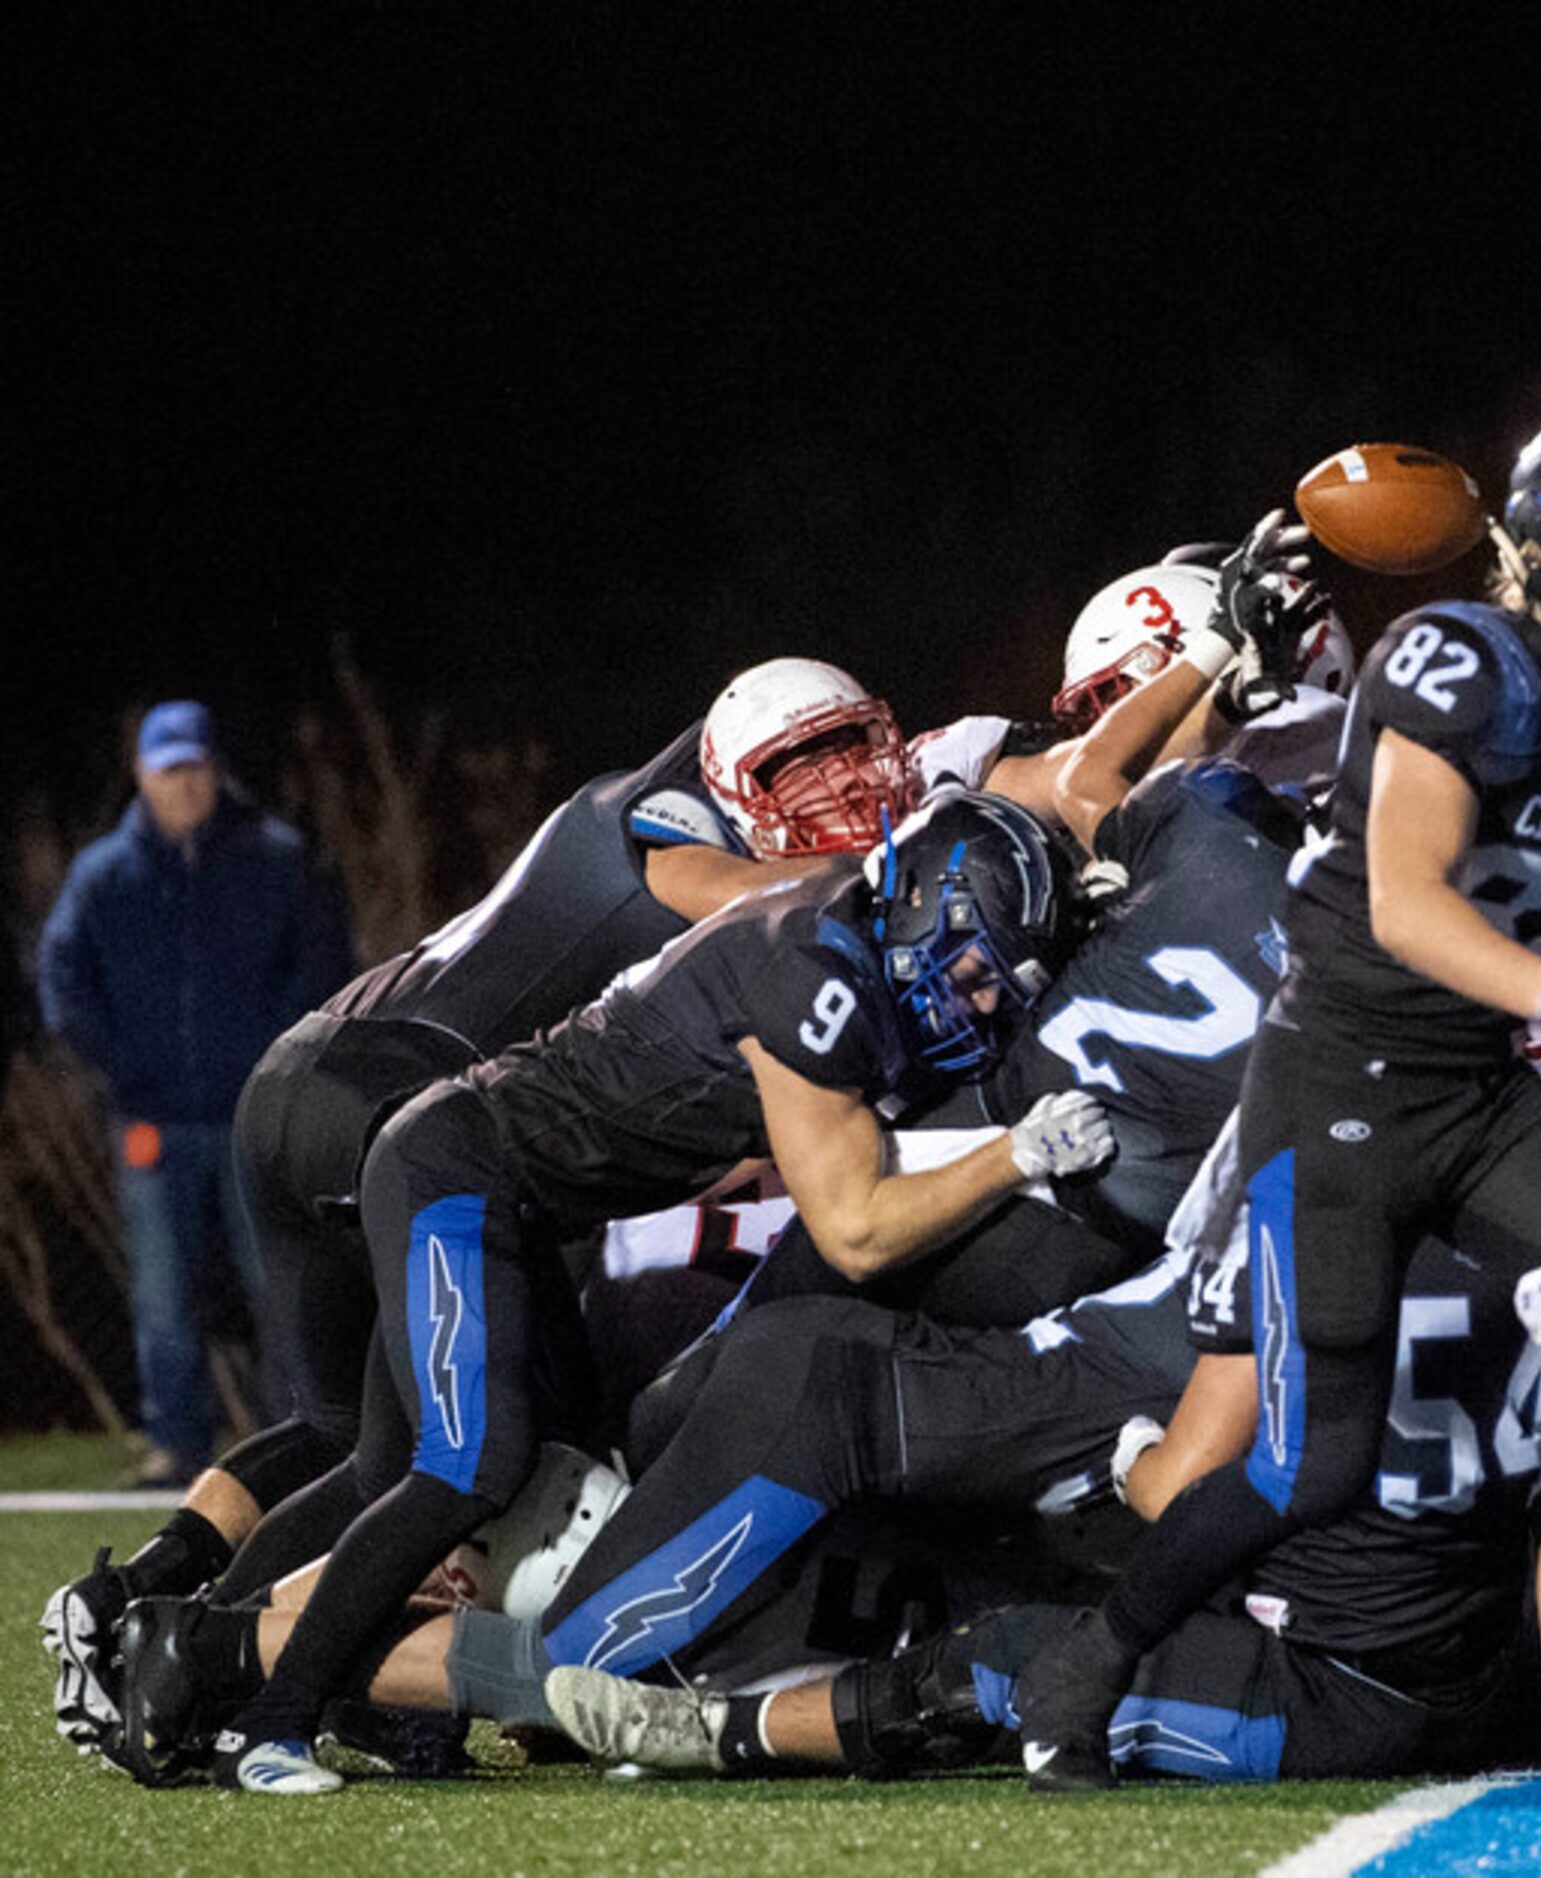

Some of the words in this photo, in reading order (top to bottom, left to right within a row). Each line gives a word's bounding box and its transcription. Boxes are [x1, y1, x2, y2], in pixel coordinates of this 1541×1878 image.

[1125, 586, 1173, 627] 3
[1384, 623, 1479, 713] 82
[798, 977, 857, 1055] 9
[1037, 946, 1261, 1093] 2
